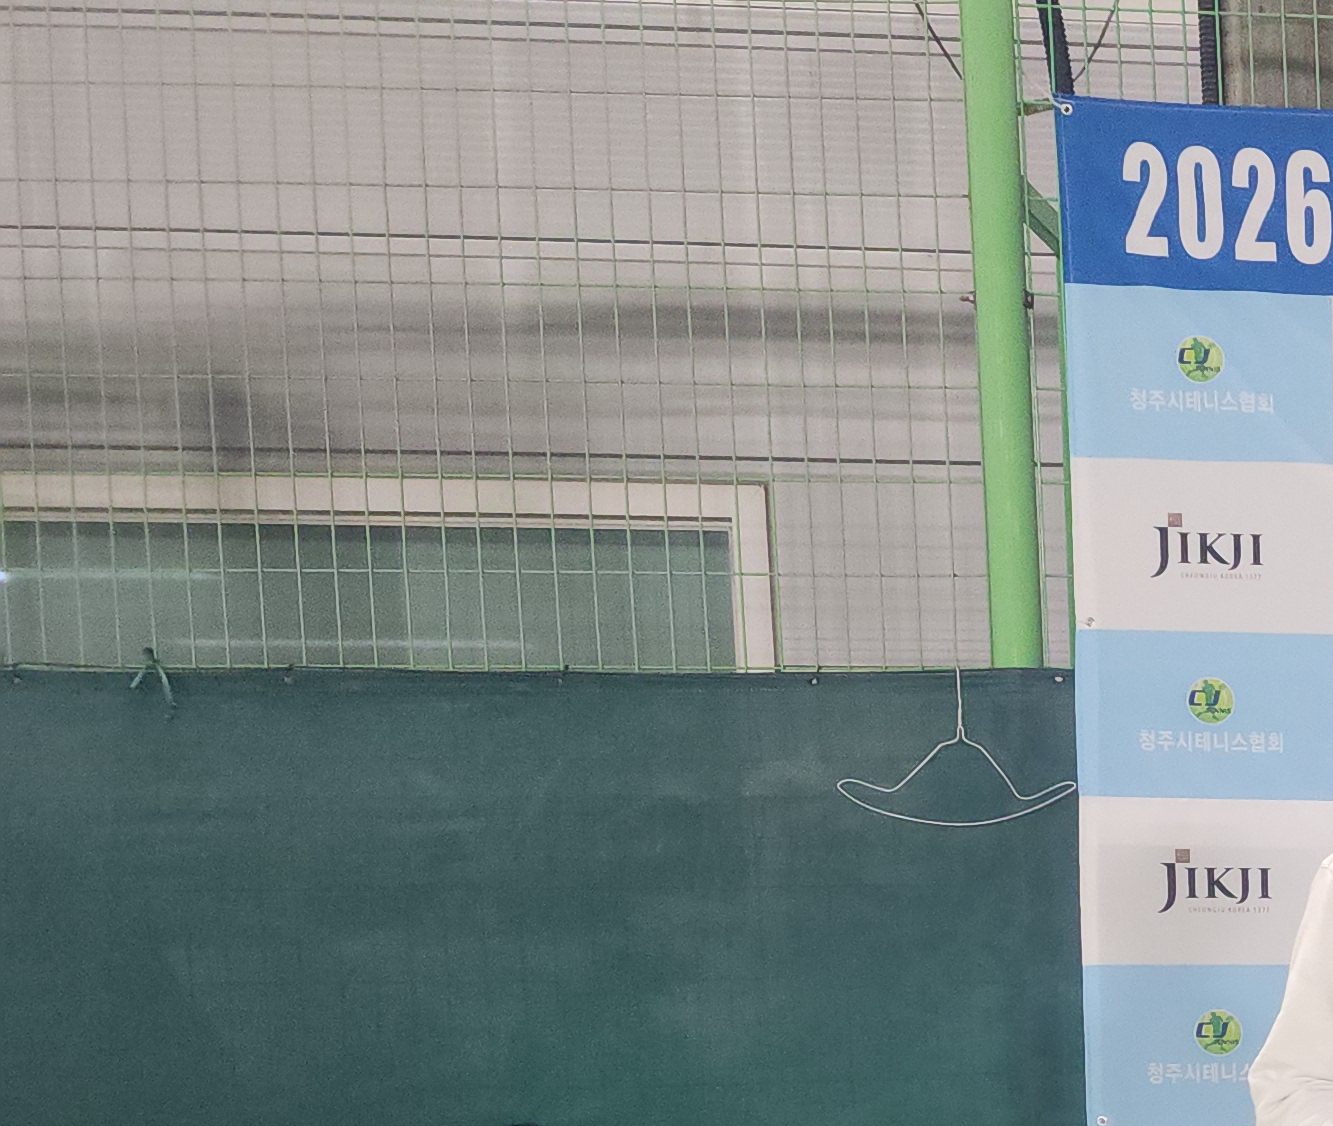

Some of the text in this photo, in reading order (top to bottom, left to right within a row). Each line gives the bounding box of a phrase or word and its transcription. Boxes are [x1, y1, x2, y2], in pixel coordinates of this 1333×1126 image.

[1121, 141, 1333, 265] 2026
[1131, 388, 1275, 414] 청주시테니스협회
[1150, 526, 1264, 578] JIKJI
[1139, 730, 1285, 754] 청주시테니스협회
[1158, 862, 1272, 913] JIKJI
[1148, 1062, 1249, 1086] 청주시테니스
